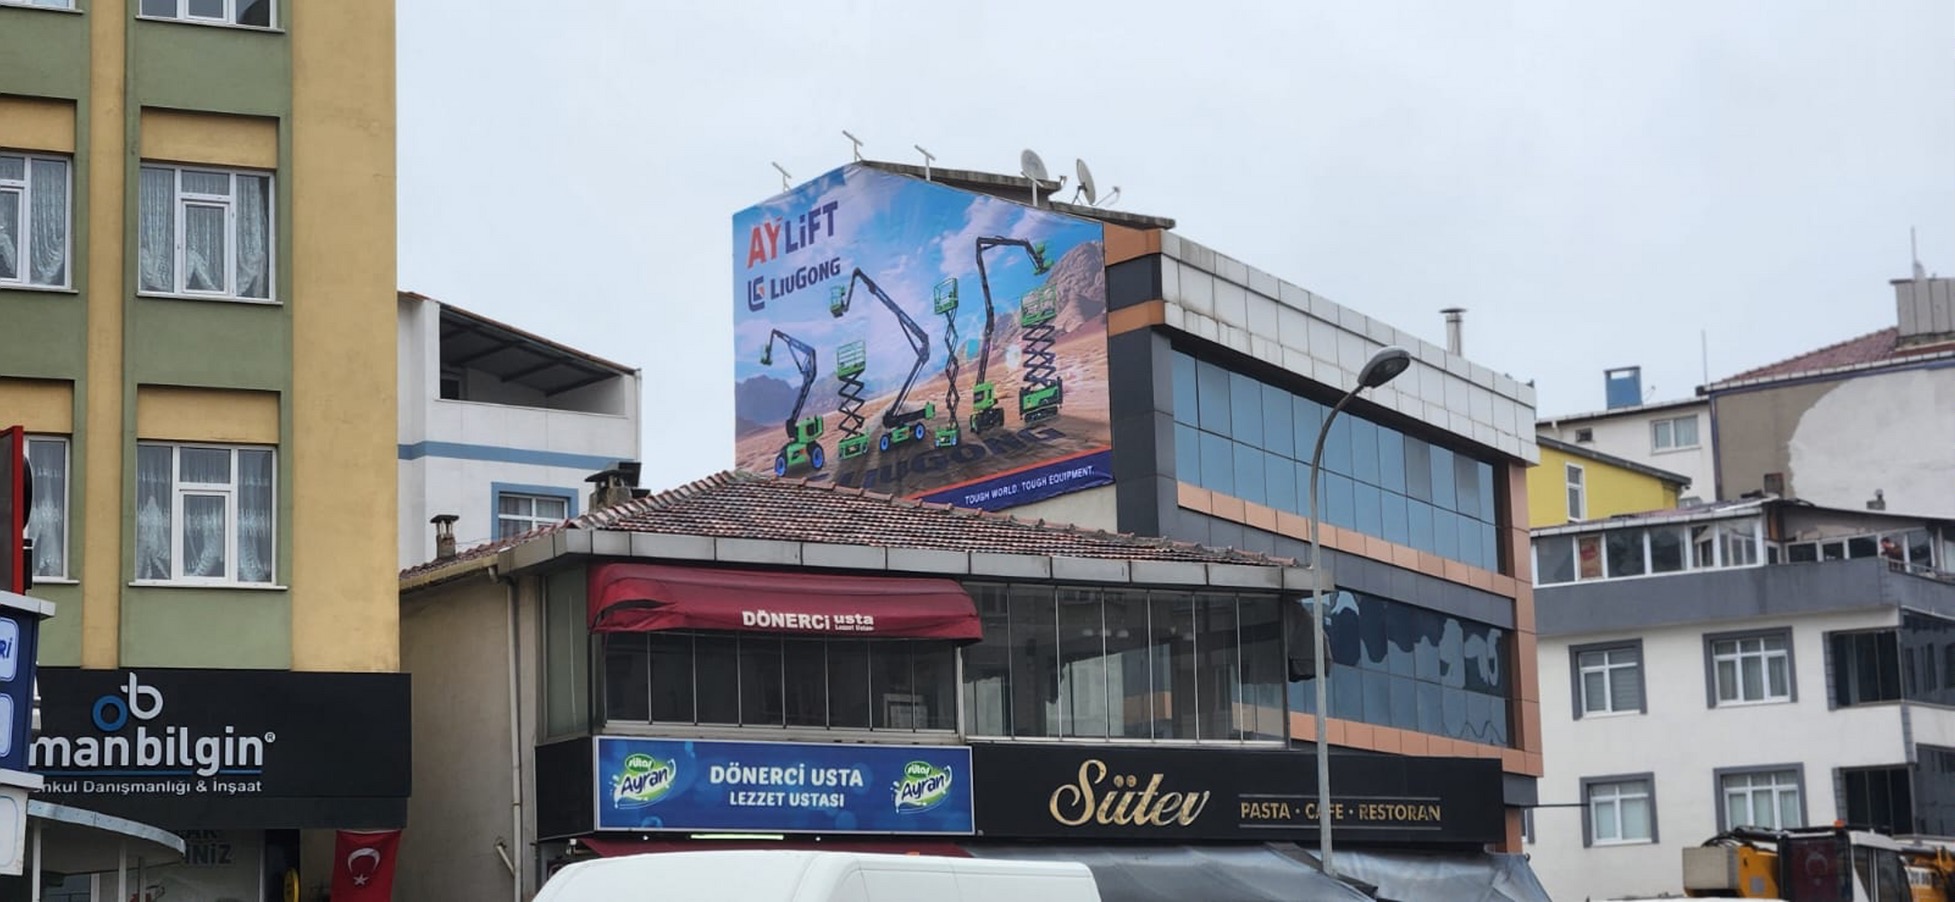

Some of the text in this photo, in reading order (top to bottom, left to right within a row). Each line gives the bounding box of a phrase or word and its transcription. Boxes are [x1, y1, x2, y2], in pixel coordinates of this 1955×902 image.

[964, 492, 990, 505] TOUGH
[1022, 478, 1047, 490] TOUGH
[833, 612, 874, 625] usta
[33, 777, 263, 796] nkul Danışmanlığı & İnşaat
[621, 768, 668, 795] Ayran
[710, 762, 864, 787] DÖNERCİ USTA
[902, 774, 945, 800] Ayran
[729, 791, 845, 807] LEZZET USTASI
[1049, 759, 1210, 826] Sütev
[1240, 802, 1291, 819] PASTA
[1358, 804, 1442, 821] RESTORAN
